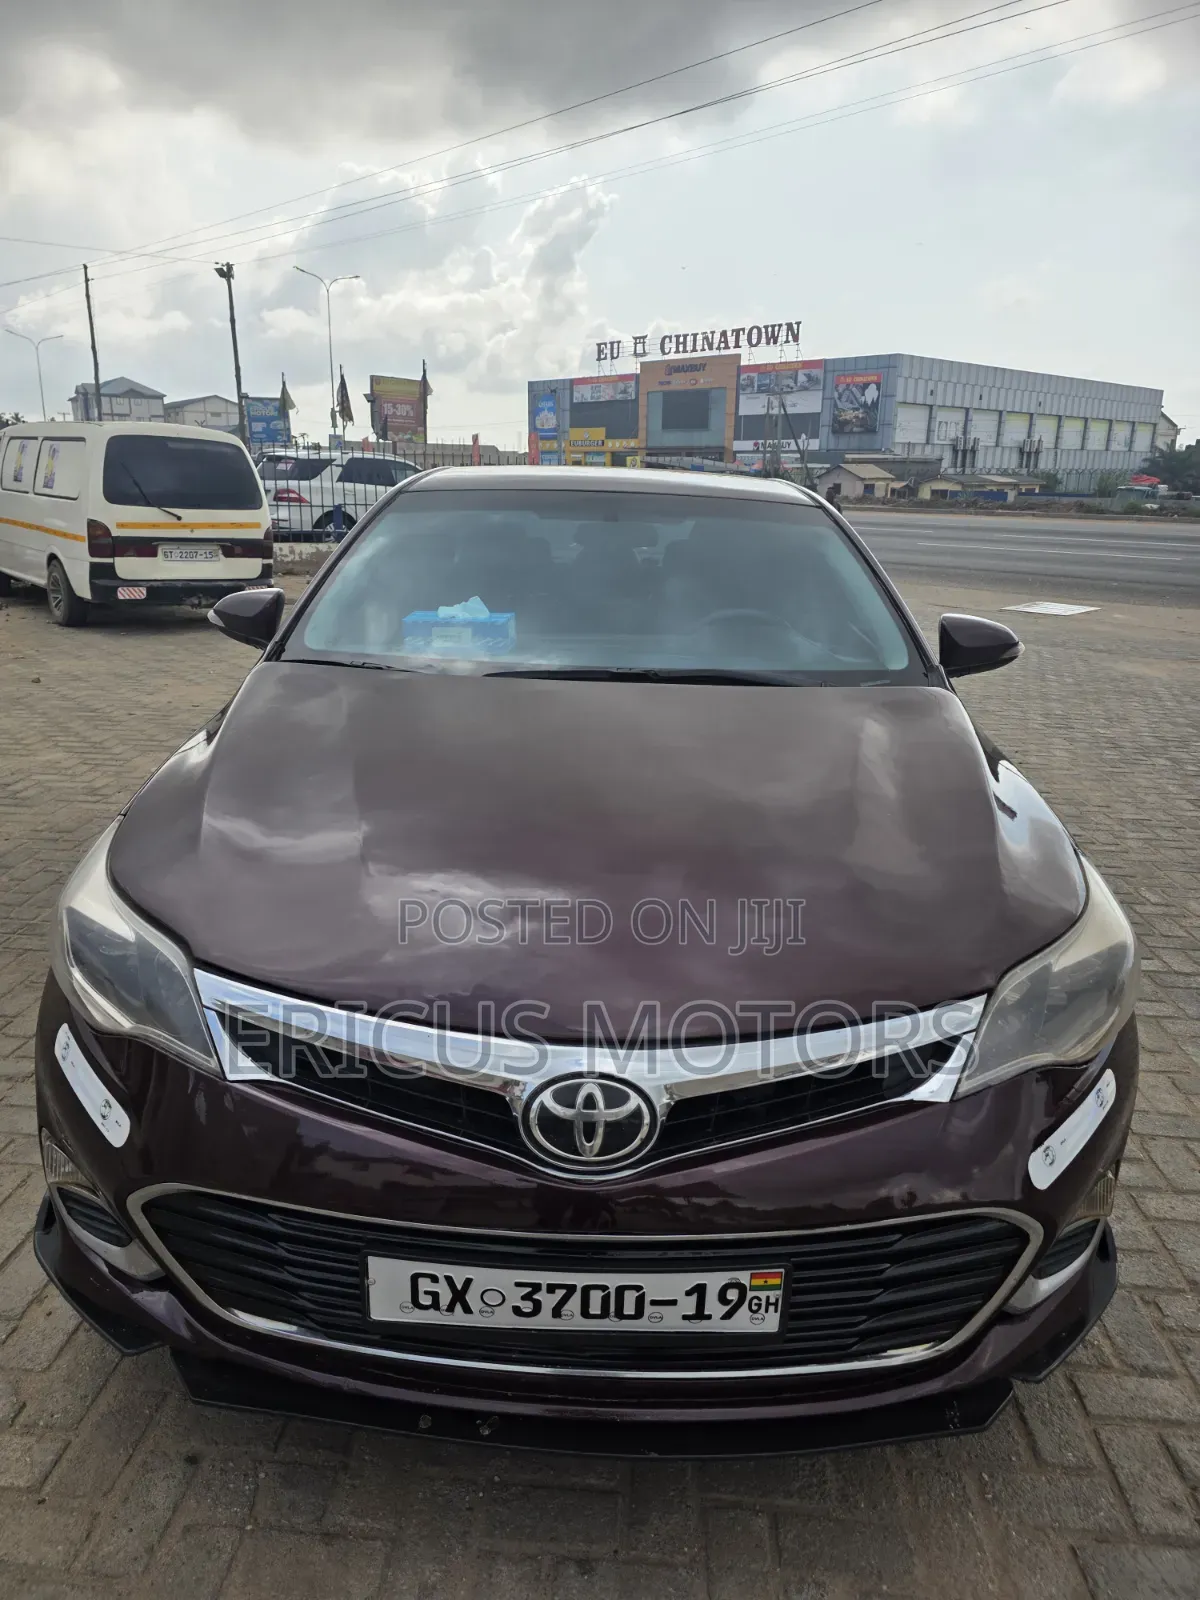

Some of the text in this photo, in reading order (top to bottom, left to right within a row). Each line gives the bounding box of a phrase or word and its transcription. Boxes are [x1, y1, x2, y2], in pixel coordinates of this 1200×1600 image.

[596, 321, 802, 361] EU CHINATOWN
[382, 402, 414, 417] 15-30%
[179, 551, 214, 559] 2207-15
[409, 1271, 779, 1322] GX 3700-19 GH
